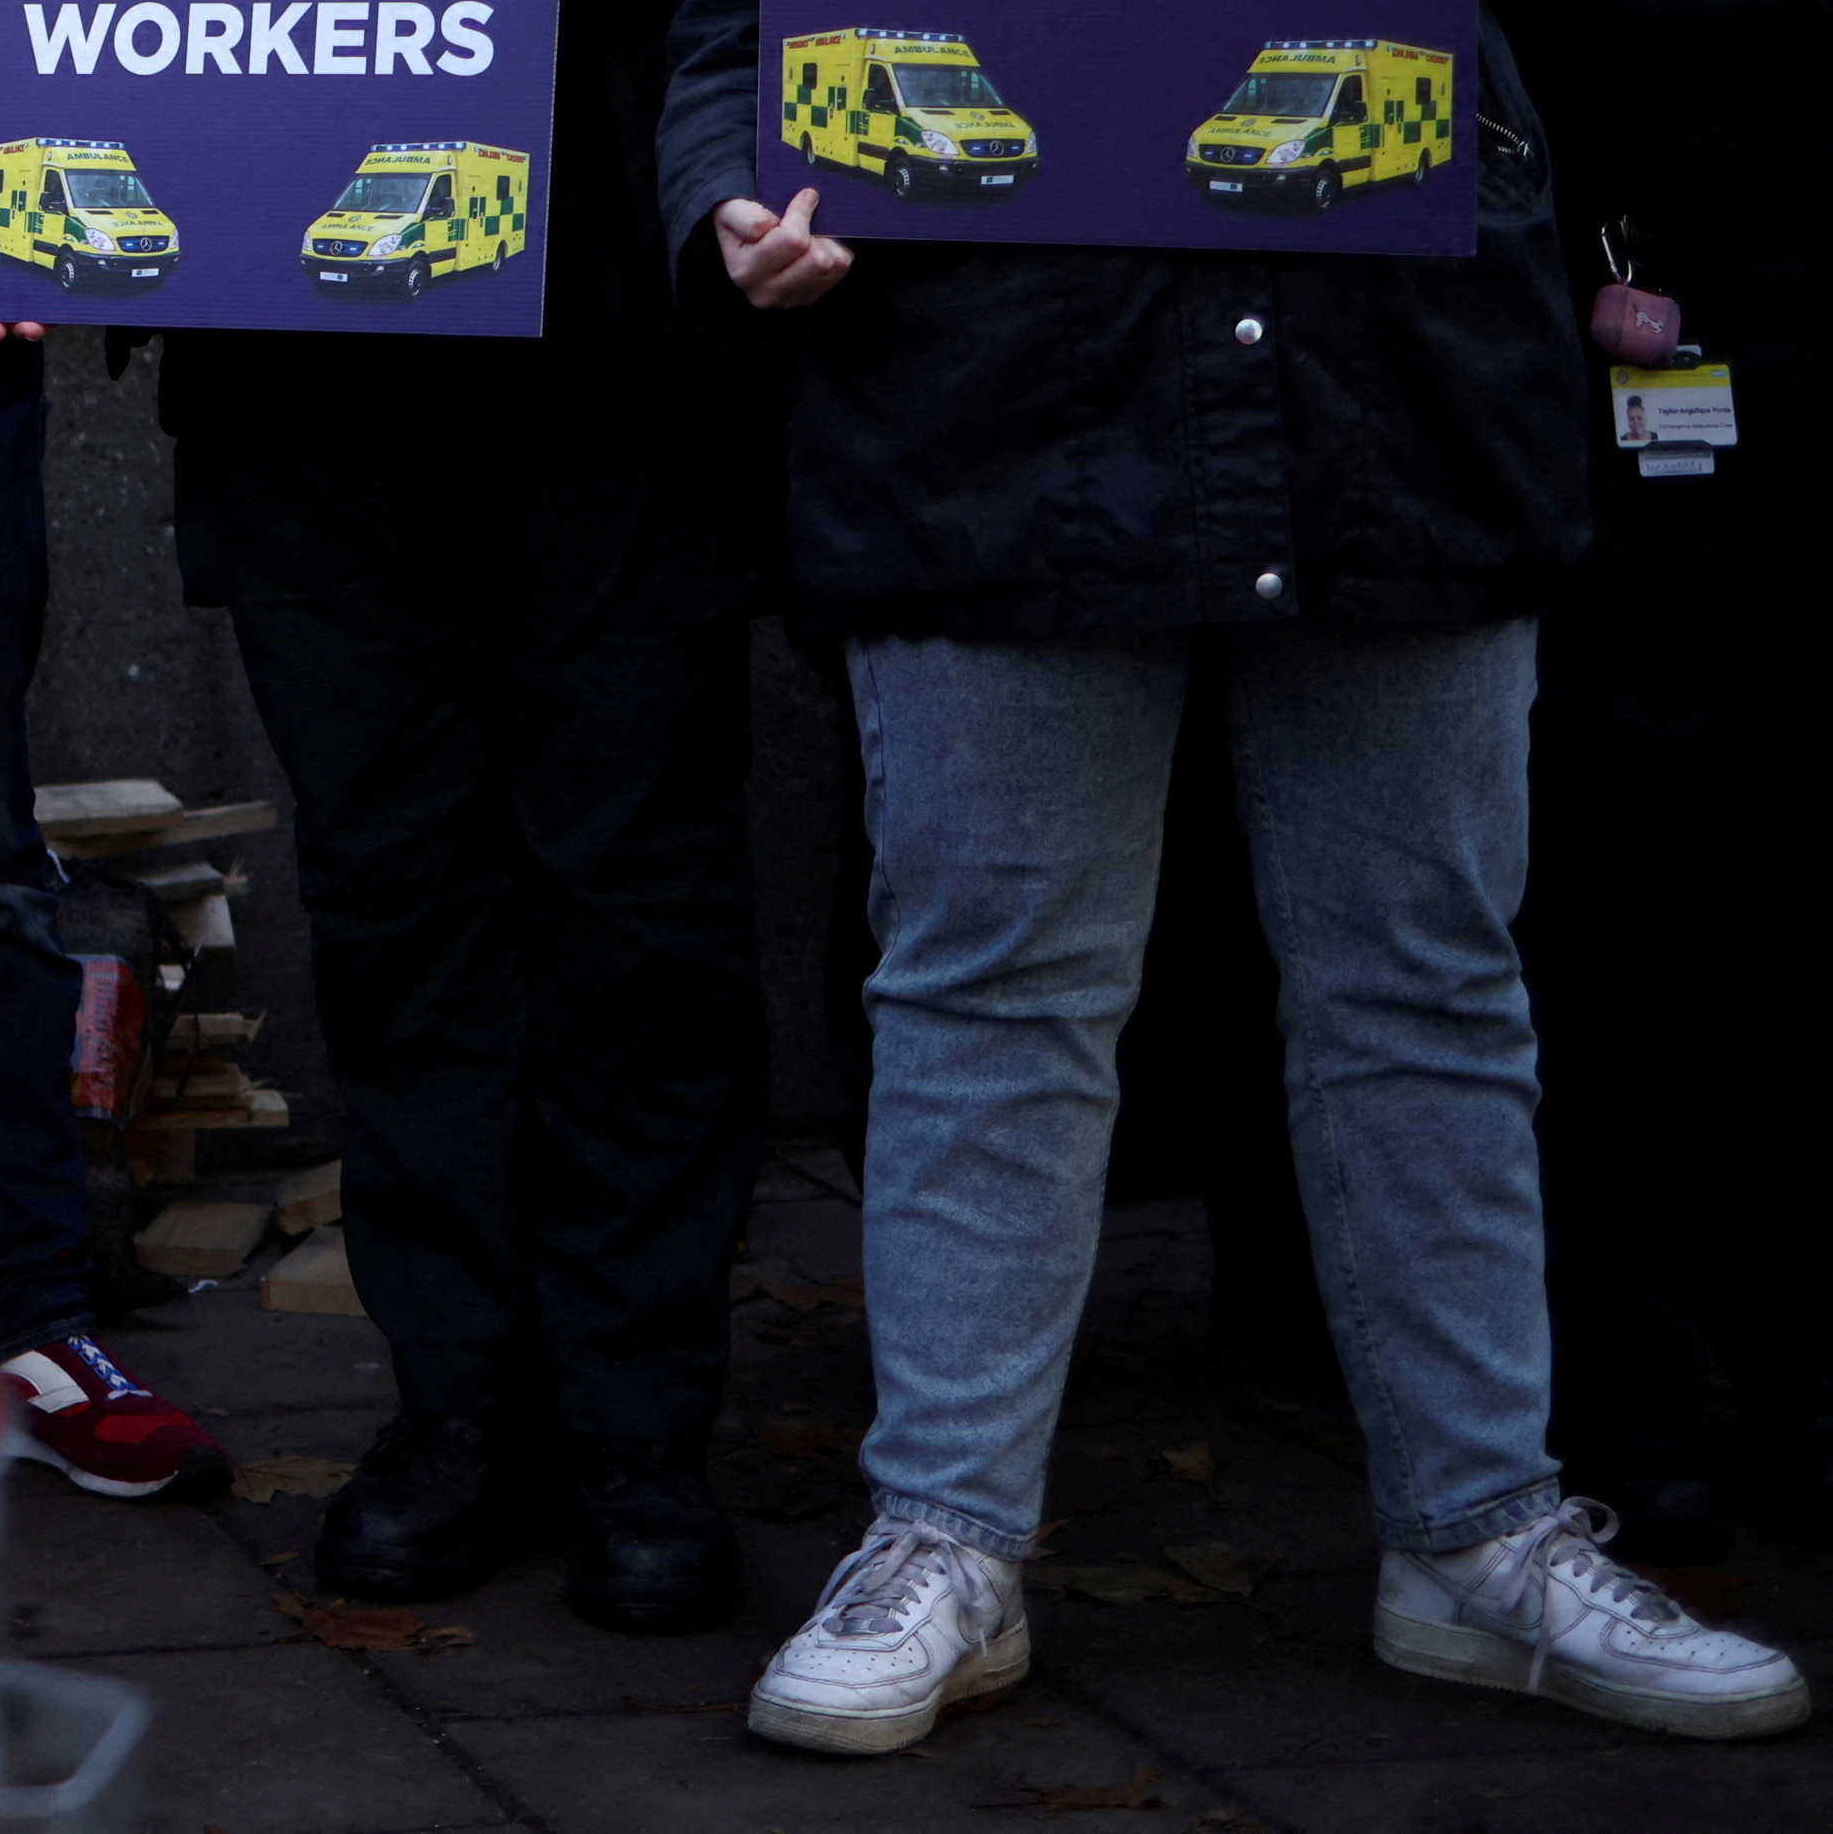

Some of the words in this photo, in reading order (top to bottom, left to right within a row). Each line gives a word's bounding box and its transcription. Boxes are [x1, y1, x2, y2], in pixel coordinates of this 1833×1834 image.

[23, 0, 495, 76] WORKERS
[894, 45, 971, 57] AMBULANCE
[67, 153, 129, 163] AMBULANCE
